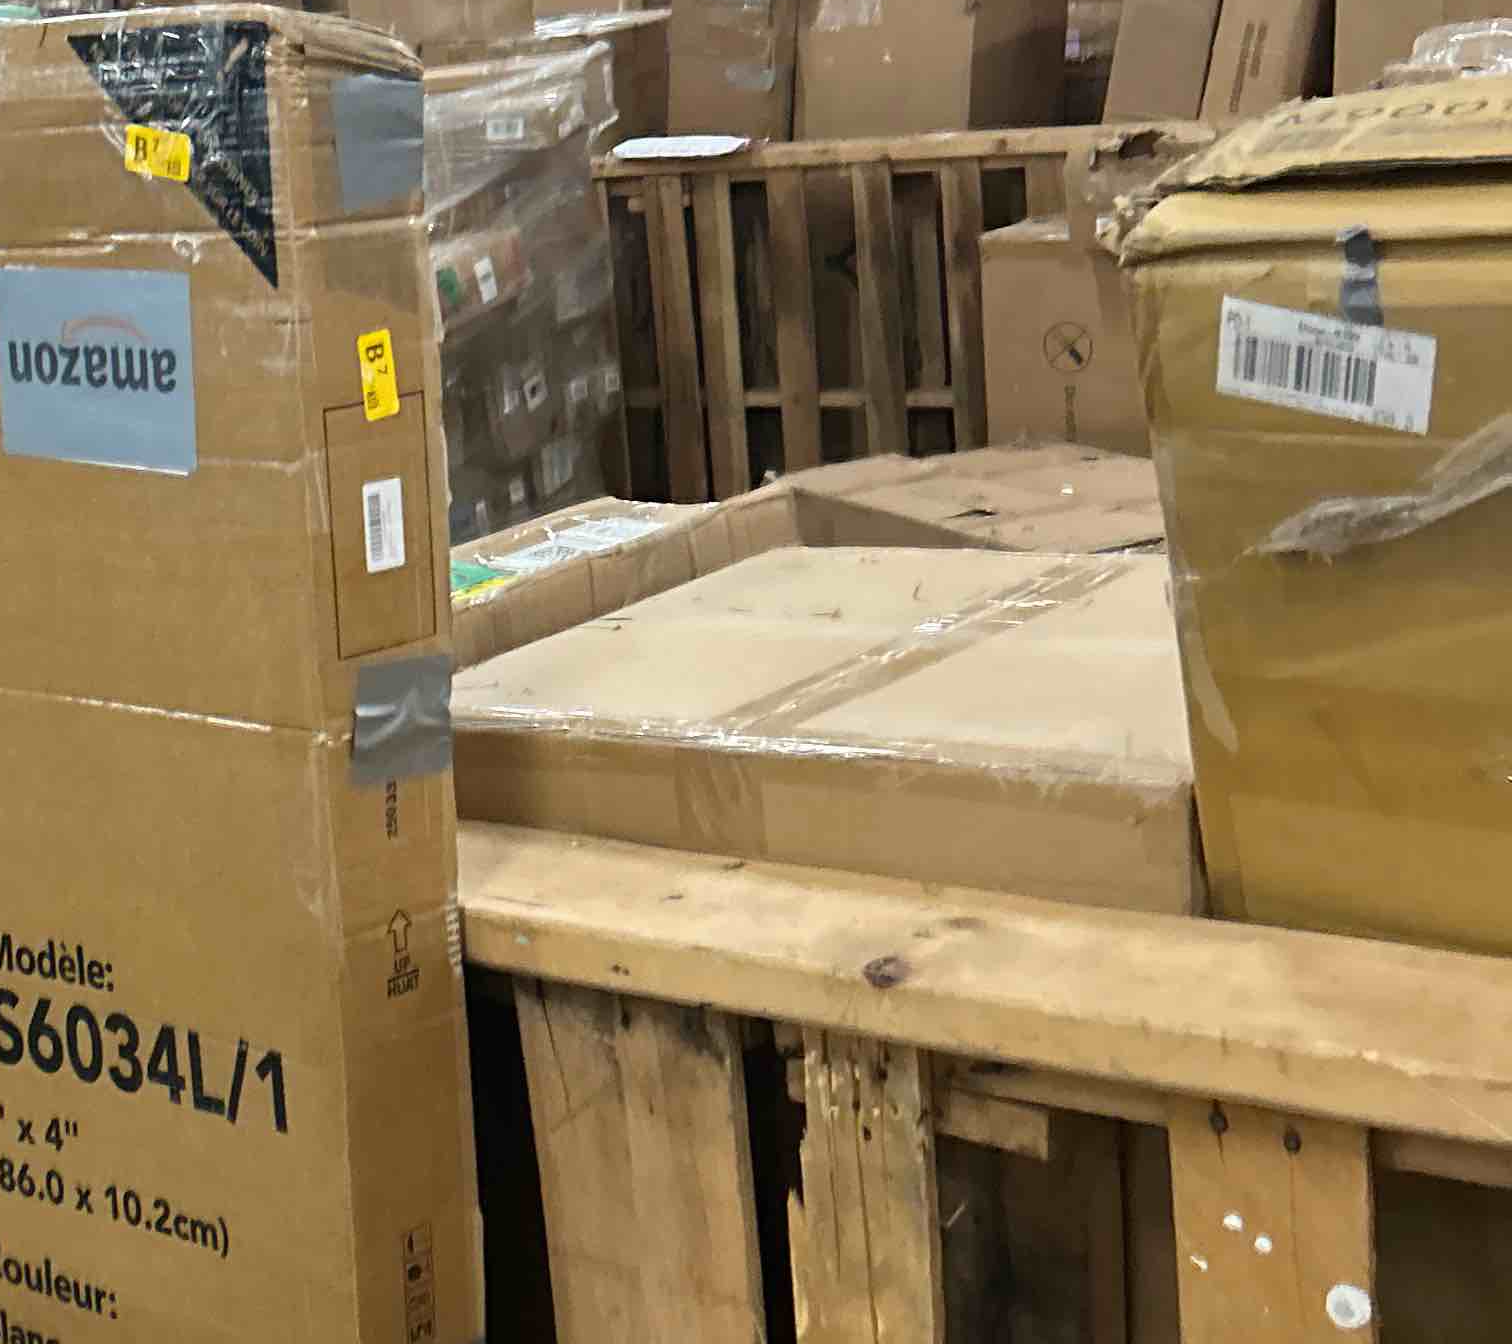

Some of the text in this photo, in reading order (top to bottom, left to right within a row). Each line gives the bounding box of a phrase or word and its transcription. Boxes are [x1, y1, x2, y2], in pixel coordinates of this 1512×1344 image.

[8, 340, 177, 393] amazon
[366, 343, 385, 363] B
[17, 1116, 35, 1146] x
[44, 1116, 79, 1152] 4"
[75, 1184, 93, 1214] x
[105, 1185, 230, 1258] 10.2cm)
